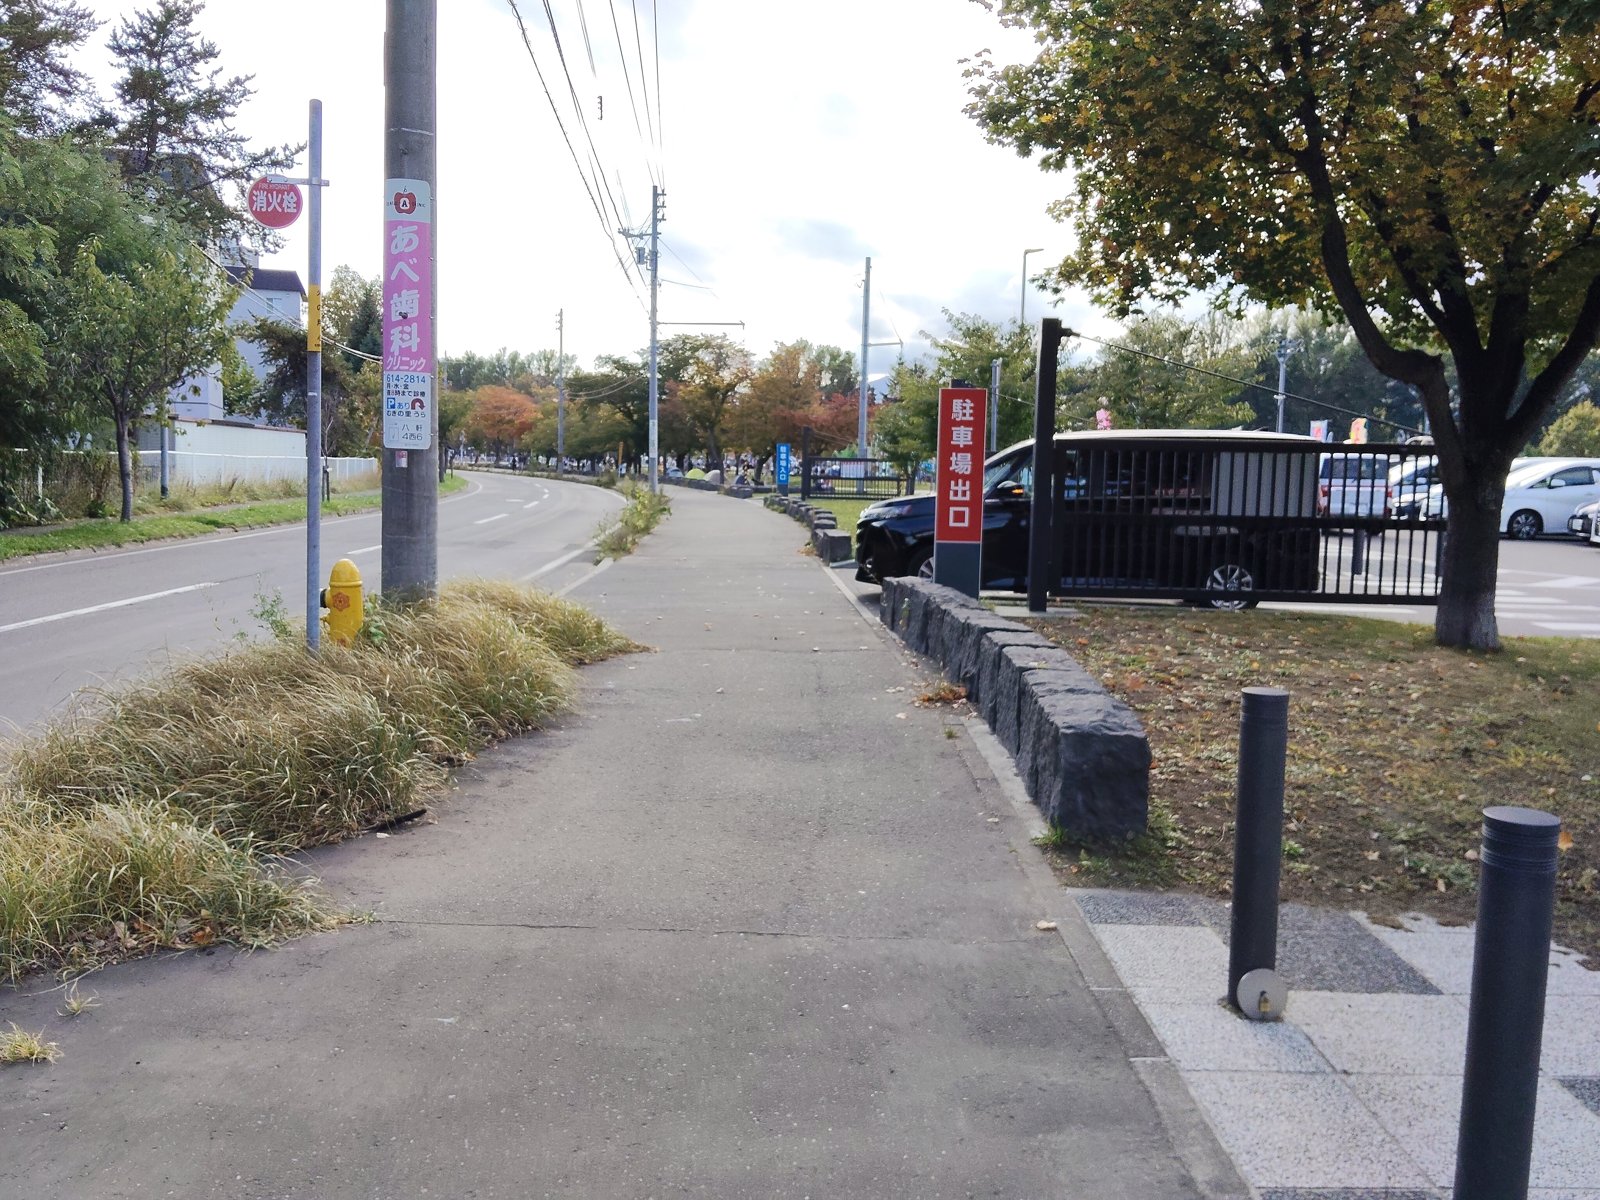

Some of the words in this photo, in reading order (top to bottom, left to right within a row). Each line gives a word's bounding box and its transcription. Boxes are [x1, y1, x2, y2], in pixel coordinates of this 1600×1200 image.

[252, 190, 298, 213] 消火栓
[401, 199, 408, 207] A
[390, 225, 421, 352] あべ歯科
[386, 355, 427, 371] クリニック
[386, 374, 426, 383] 614-2814
[402, 433, 423, 441] 4西6
[949, 399, 974, 527] 駐車場出口
